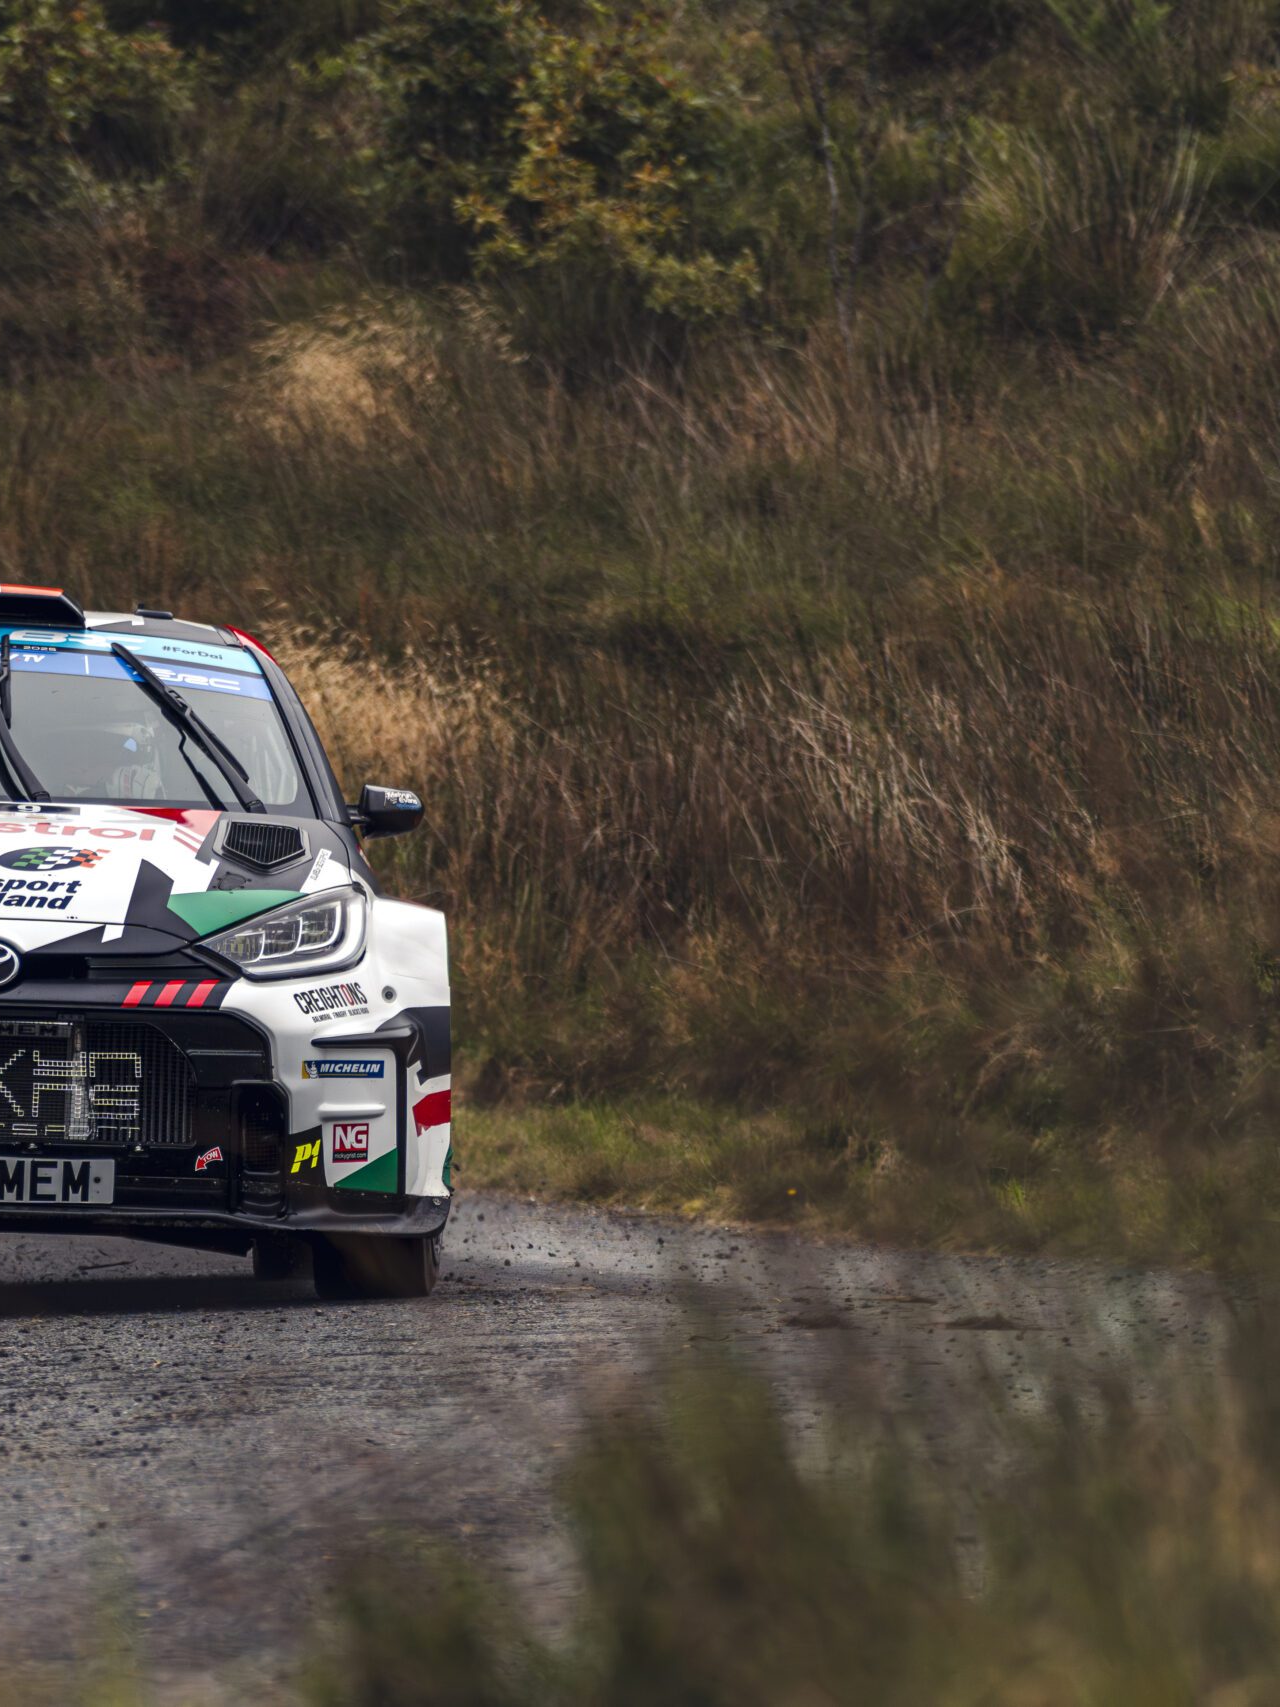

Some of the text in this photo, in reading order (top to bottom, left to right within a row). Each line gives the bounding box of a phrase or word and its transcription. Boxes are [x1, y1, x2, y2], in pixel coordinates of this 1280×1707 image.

[22, 654, 46, 663] TV
[162, 645, 223, 660] #ForDai
[17, 804, 41, 813] 9
[293, 982, 368, 1014] CREIGHTONS
[320, 1063, 381, 1073] MICHELIN
[334, 1125, 368, 1150] NG
[290, 1139, 321, 1174] P1
[334, 1151, 367, 1160] nickygrist.com
